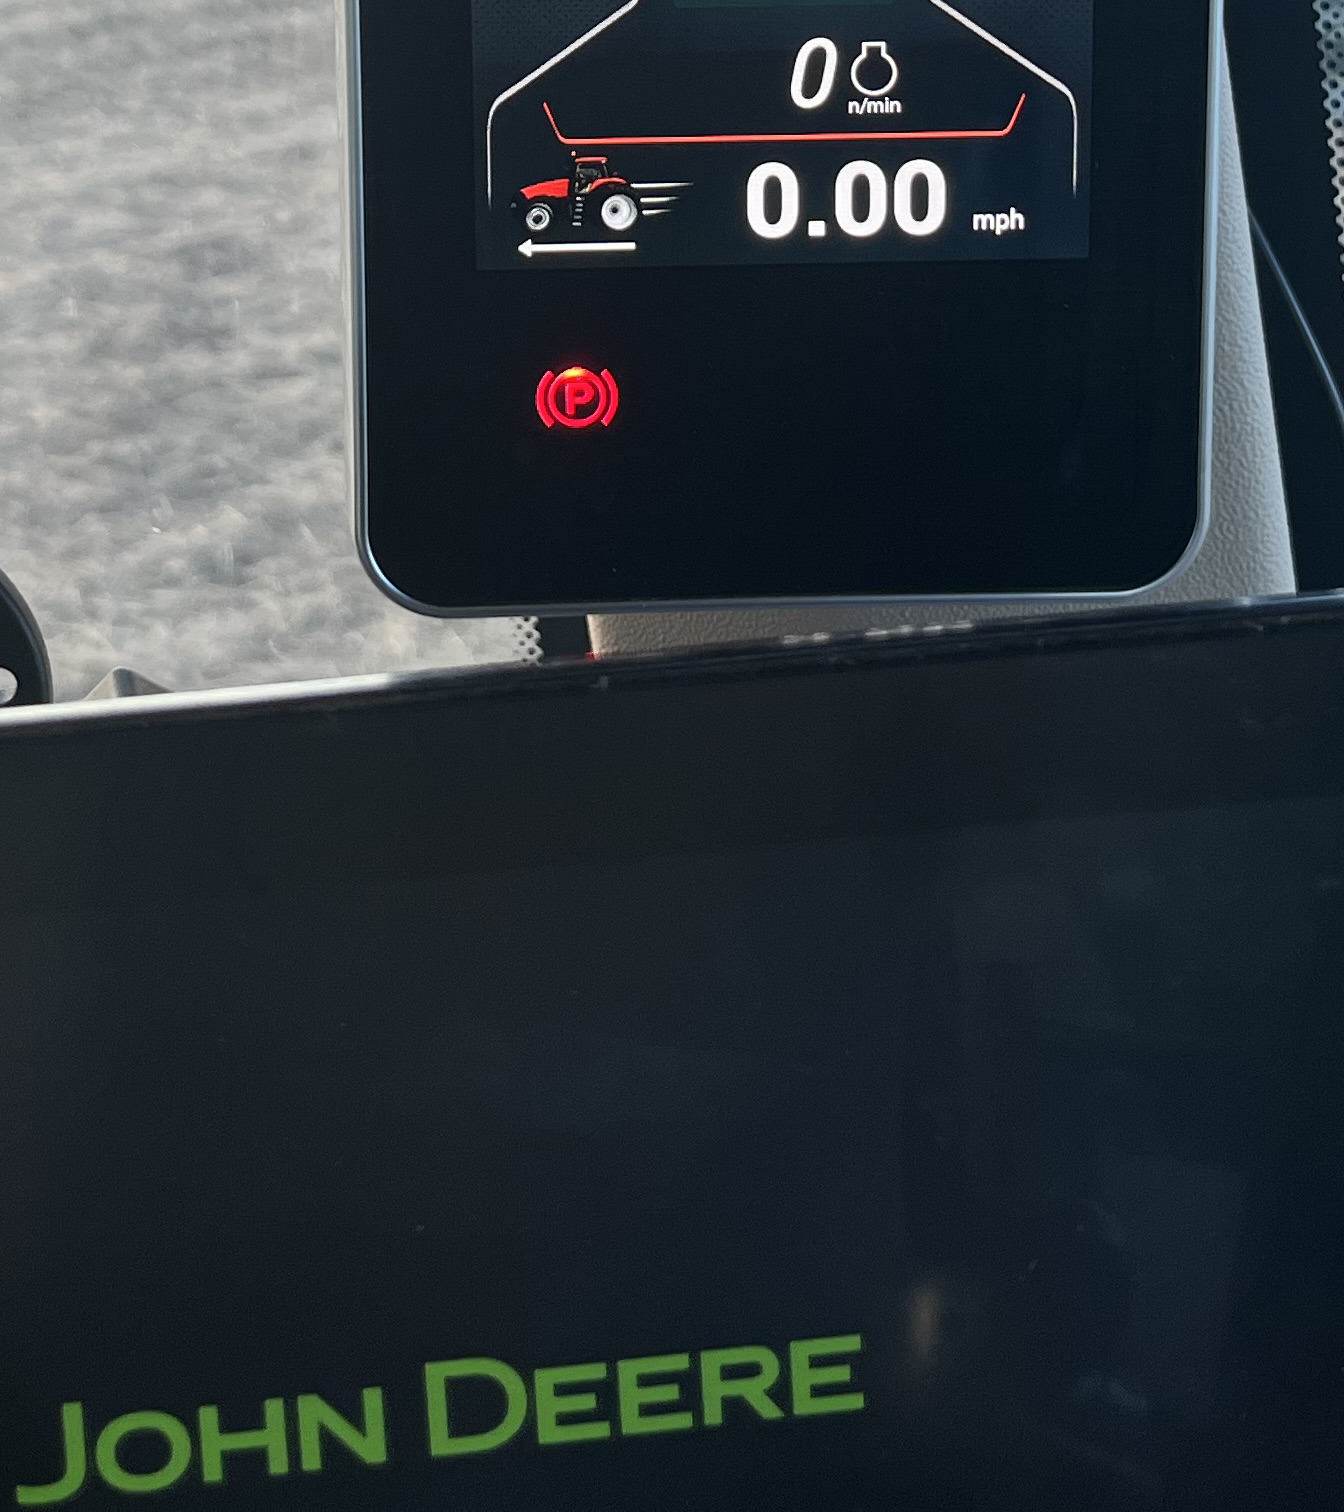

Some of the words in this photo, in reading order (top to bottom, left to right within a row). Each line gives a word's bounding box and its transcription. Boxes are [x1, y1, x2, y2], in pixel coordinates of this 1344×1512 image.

[791, 37, 838, 110] 0
[847, 97, 902, 115] n/min
[746, 159, 948, 239] 0.00
[973, 207, 1025, 236] mph
[16, 1387, 387, 1504] JOHN
[424, 1335, 865, 1457] DEERE
